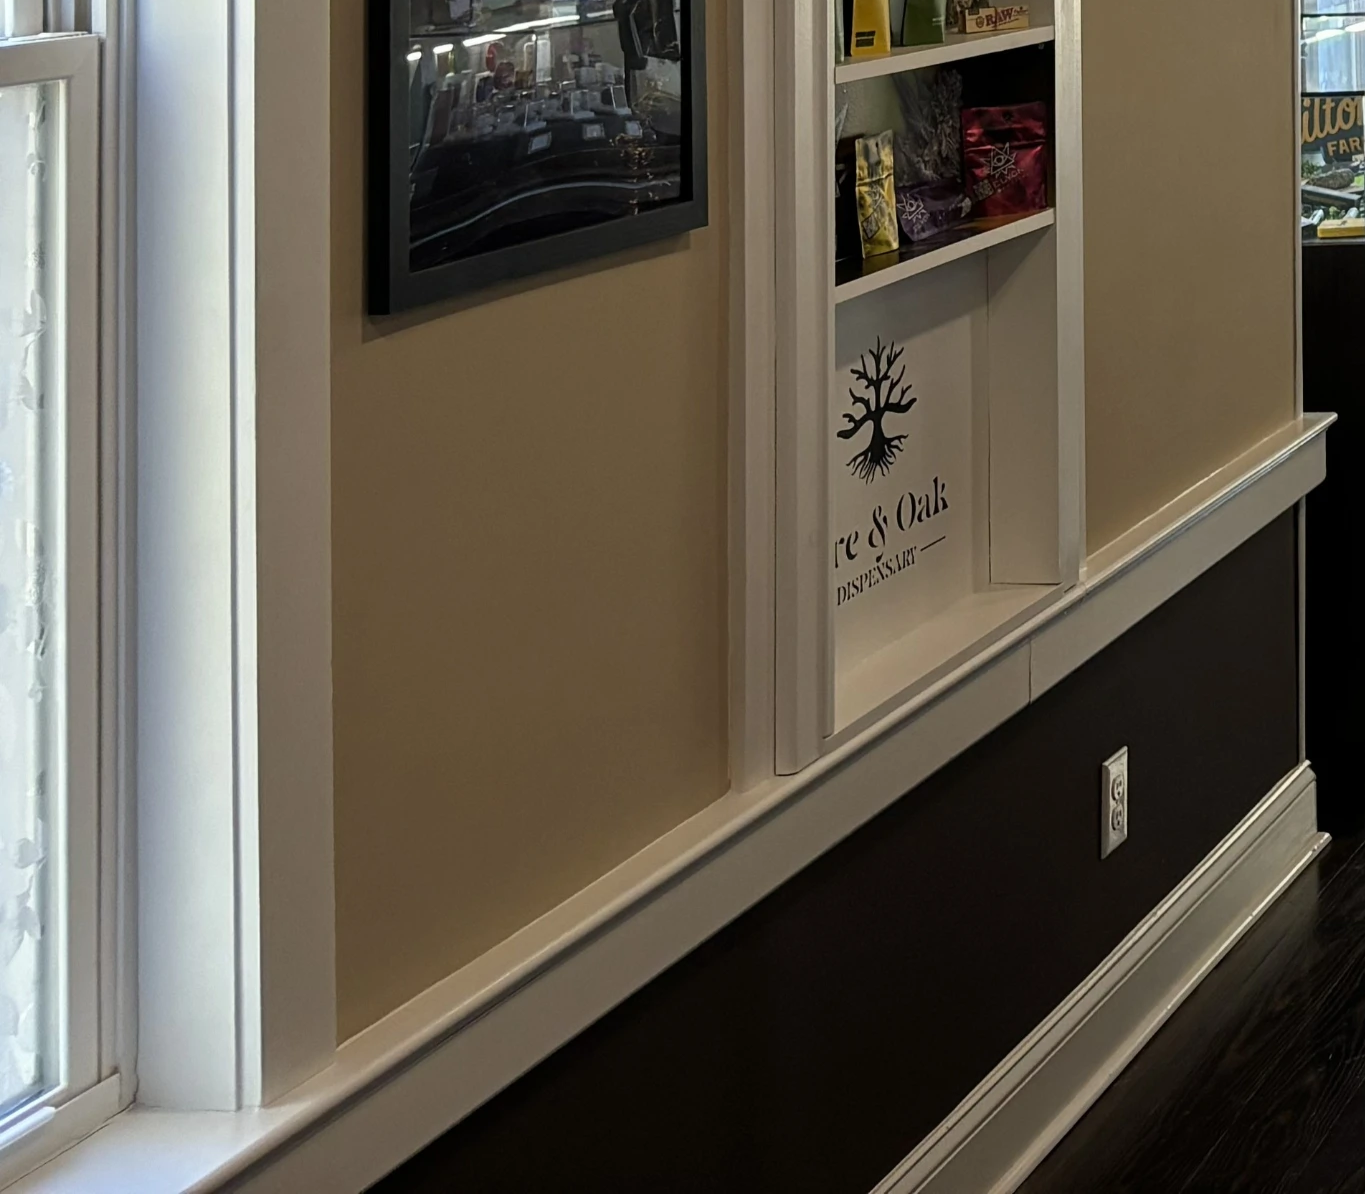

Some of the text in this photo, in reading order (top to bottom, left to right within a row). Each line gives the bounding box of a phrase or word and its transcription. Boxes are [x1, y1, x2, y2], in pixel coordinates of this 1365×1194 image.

[985, 8, 1014, 27] RAW
[1327, 137, 1362, 156] FAR
[834, 477, 949, 569] re & Oak
[836, 545, 917, 607] DISPENSARY
